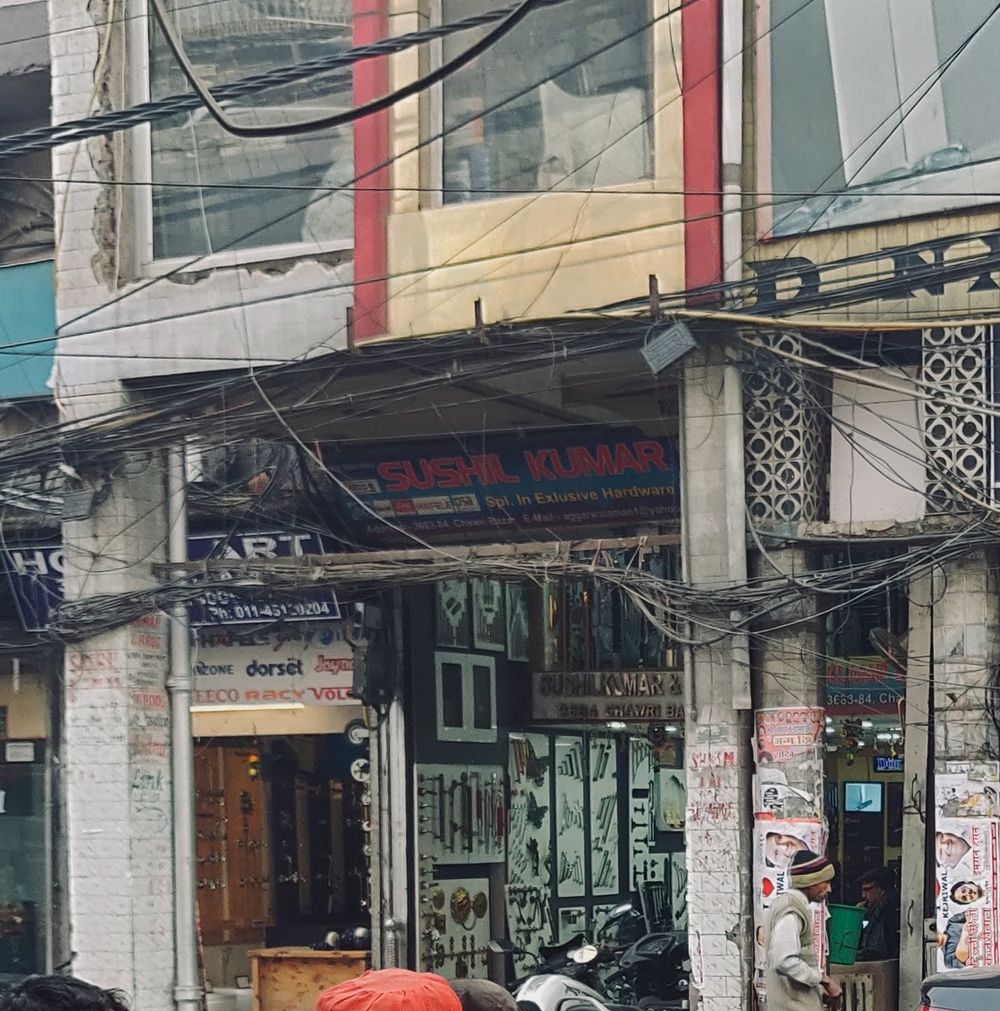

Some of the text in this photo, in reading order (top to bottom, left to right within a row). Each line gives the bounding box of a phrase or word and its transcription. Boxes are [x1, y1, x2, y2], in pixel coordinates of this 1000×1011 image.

[377, 441, 669, 492] SUSHIL KUMAR
[485, 495, 514, 509] Spl.
[517, 494, 531, 505] In
[535, 489, 599, 505] Exlusive
